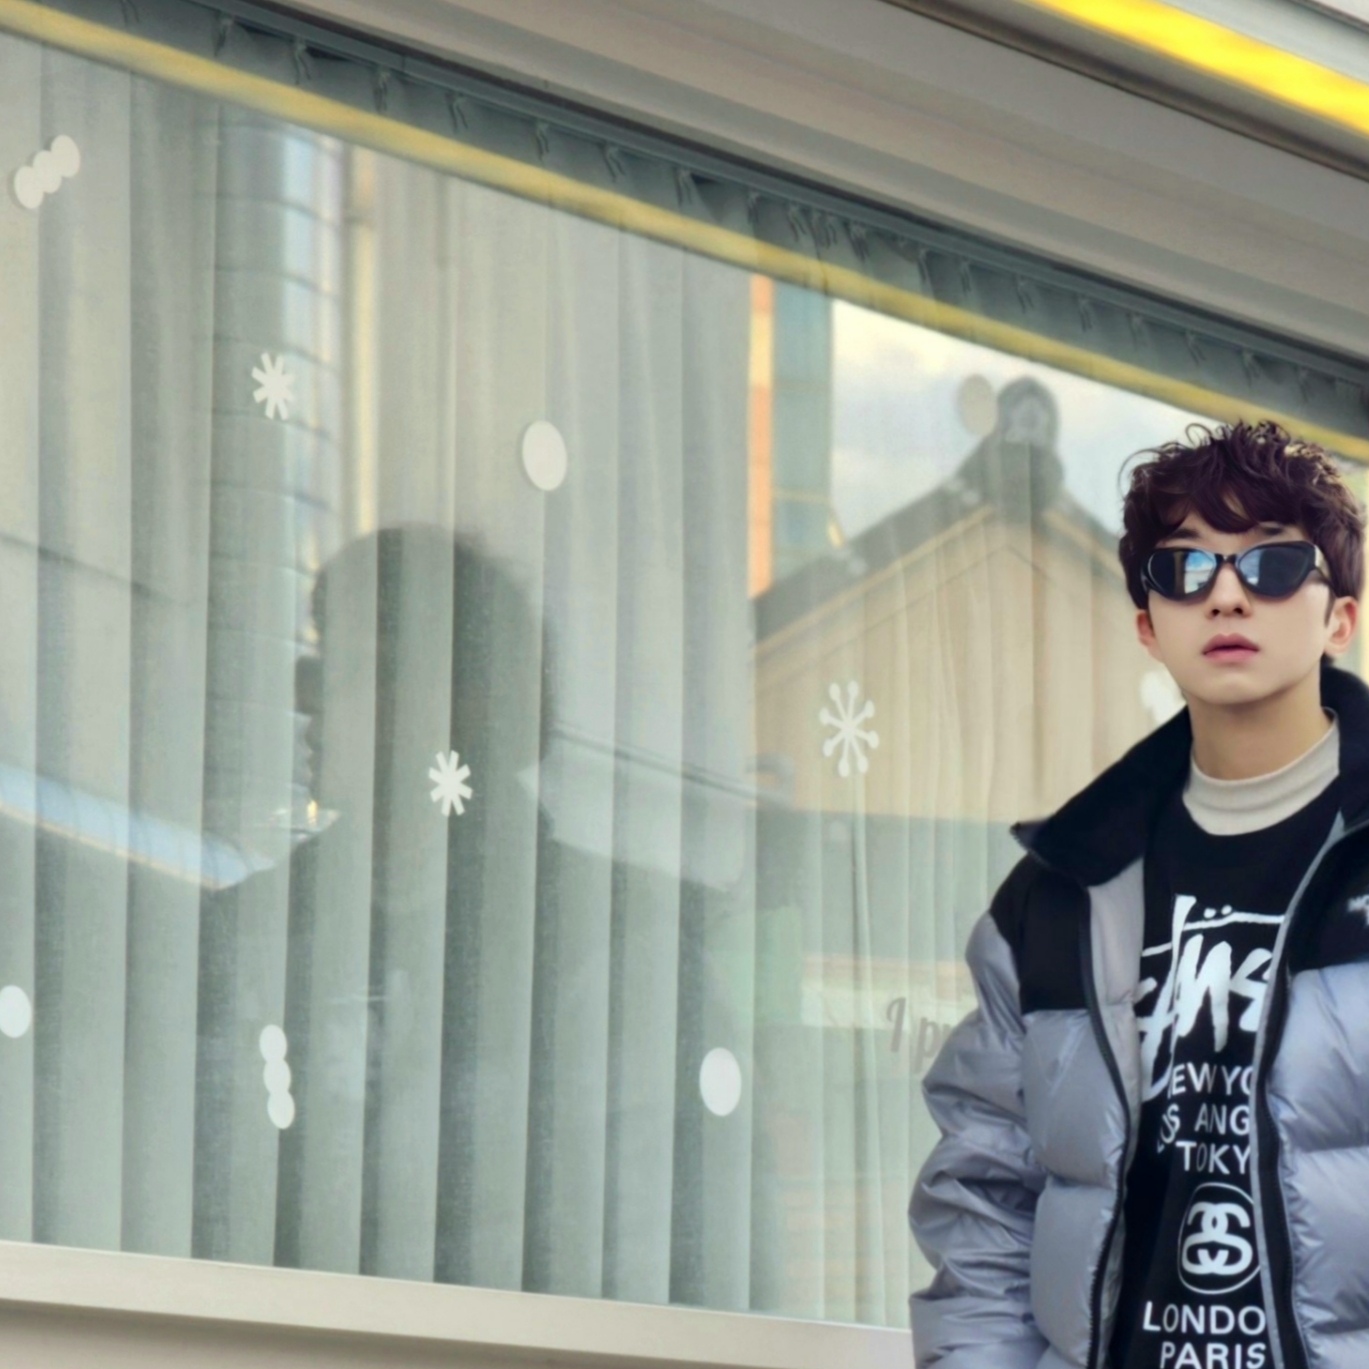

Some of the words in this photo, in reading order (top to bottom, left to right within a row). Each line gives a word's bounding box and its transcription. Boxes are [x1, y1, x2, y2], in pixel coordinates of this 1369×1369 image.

[1172, 1062, 1217, 1095] EW
[1194, 1103, 1250, 1136] ANG
[1175, 1140, 1251, 1175] TOKY
[1143, 1300, 1267, 1336] LONDO
